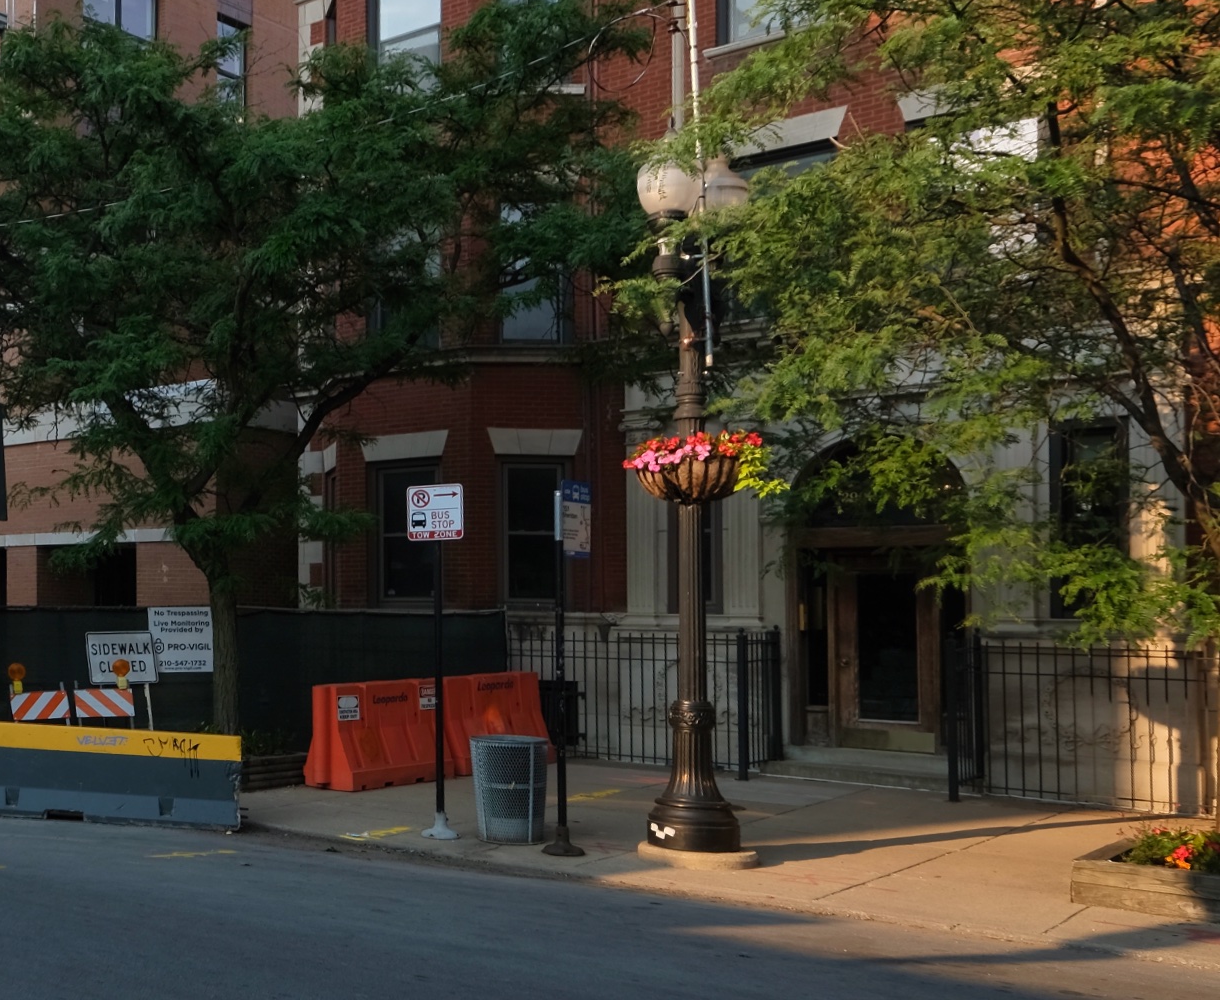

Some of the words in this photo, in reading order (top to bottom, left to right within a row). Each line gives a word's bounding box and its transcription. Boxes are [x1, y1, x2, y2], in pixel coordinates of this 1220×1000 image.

[431, 511, 450, 519] BUS
[431, 520, 455, 529] STOP
[411, 531, 430, 539] TOW
[433, 530, 458, 538] ZONE
[195, 626, 204, 634] by
[91, 642, 151, 656] SIDEWALK
[167, 643, 212, 651] PRO-VIGIL
[99, 660, 147, 673] CLED
